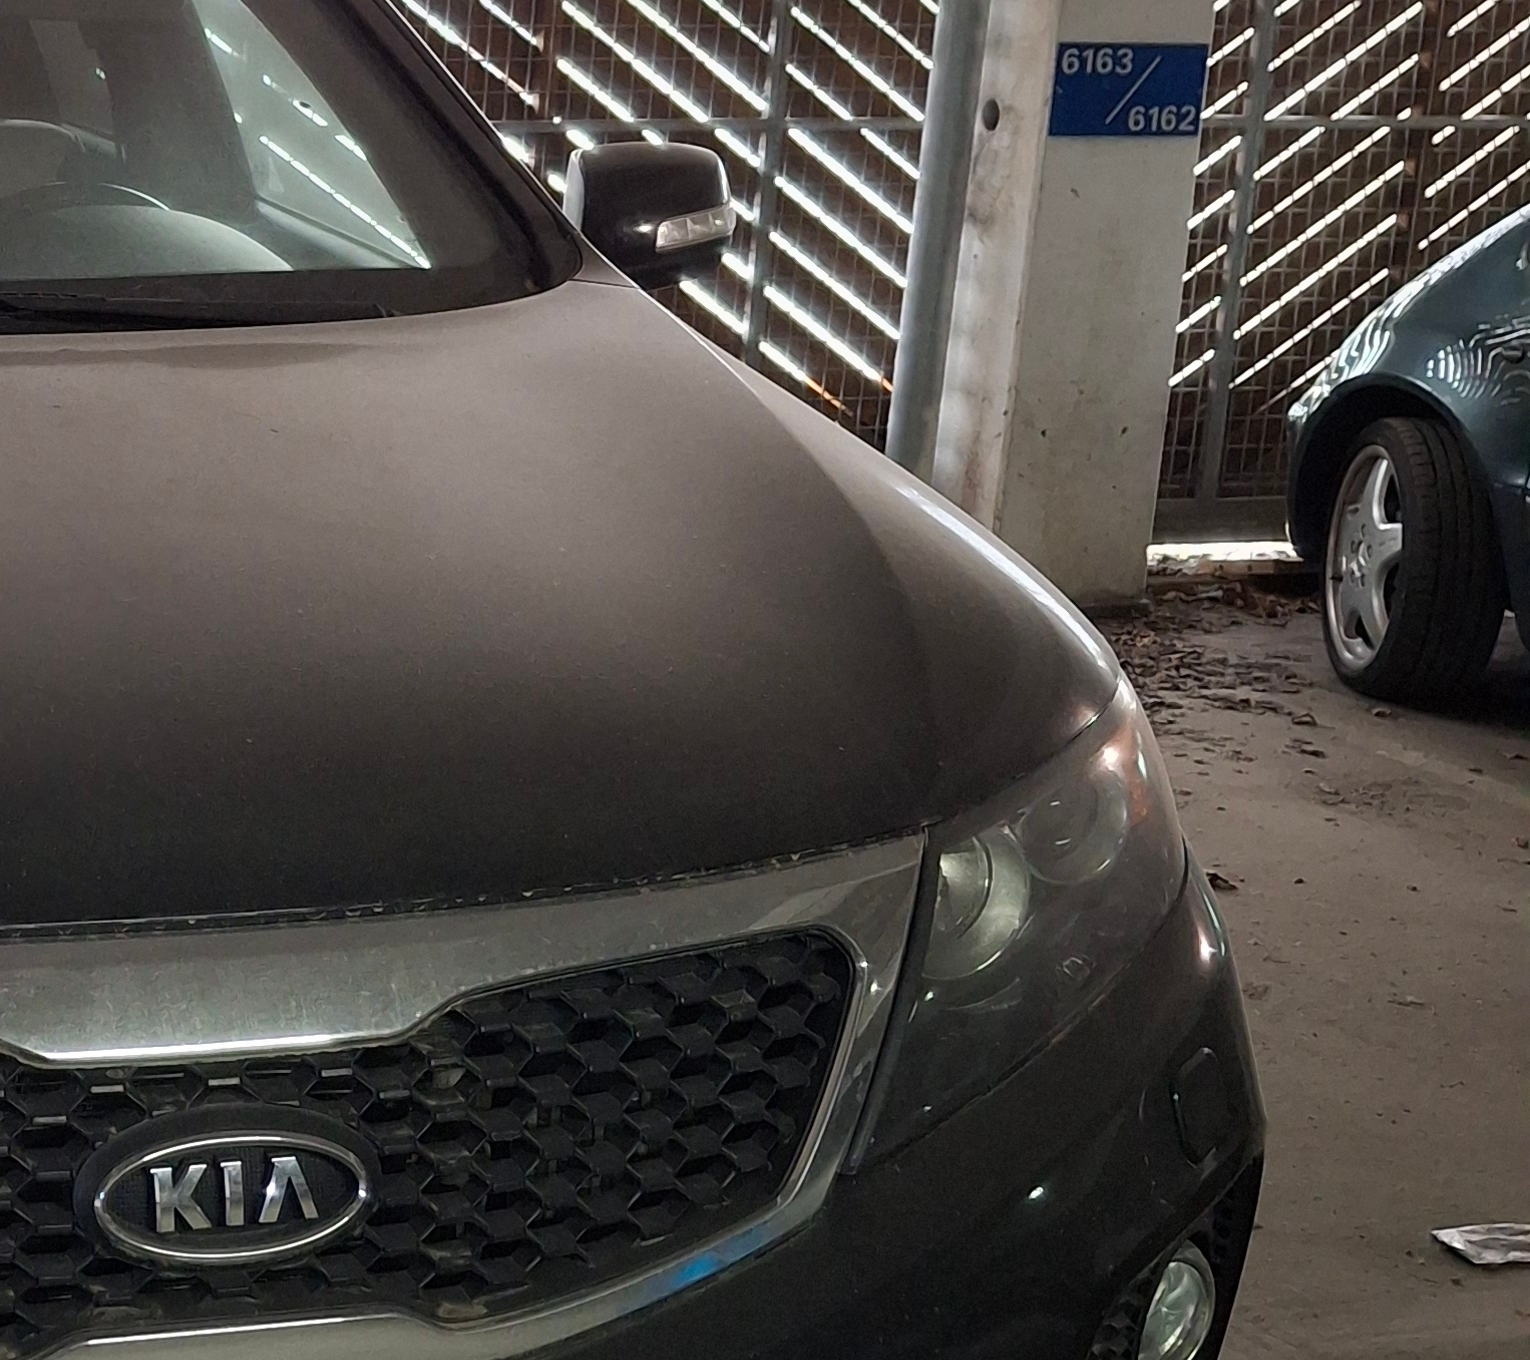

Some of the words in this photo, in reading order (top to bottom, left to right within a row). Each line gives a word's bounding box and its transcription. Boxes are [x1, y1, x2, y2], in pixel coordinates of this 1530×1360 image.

[1061, 48, 1133, 74] 6163
[1128, 105, 1196, 131] 6162
[150, 1156, 319, 1233] KIA
